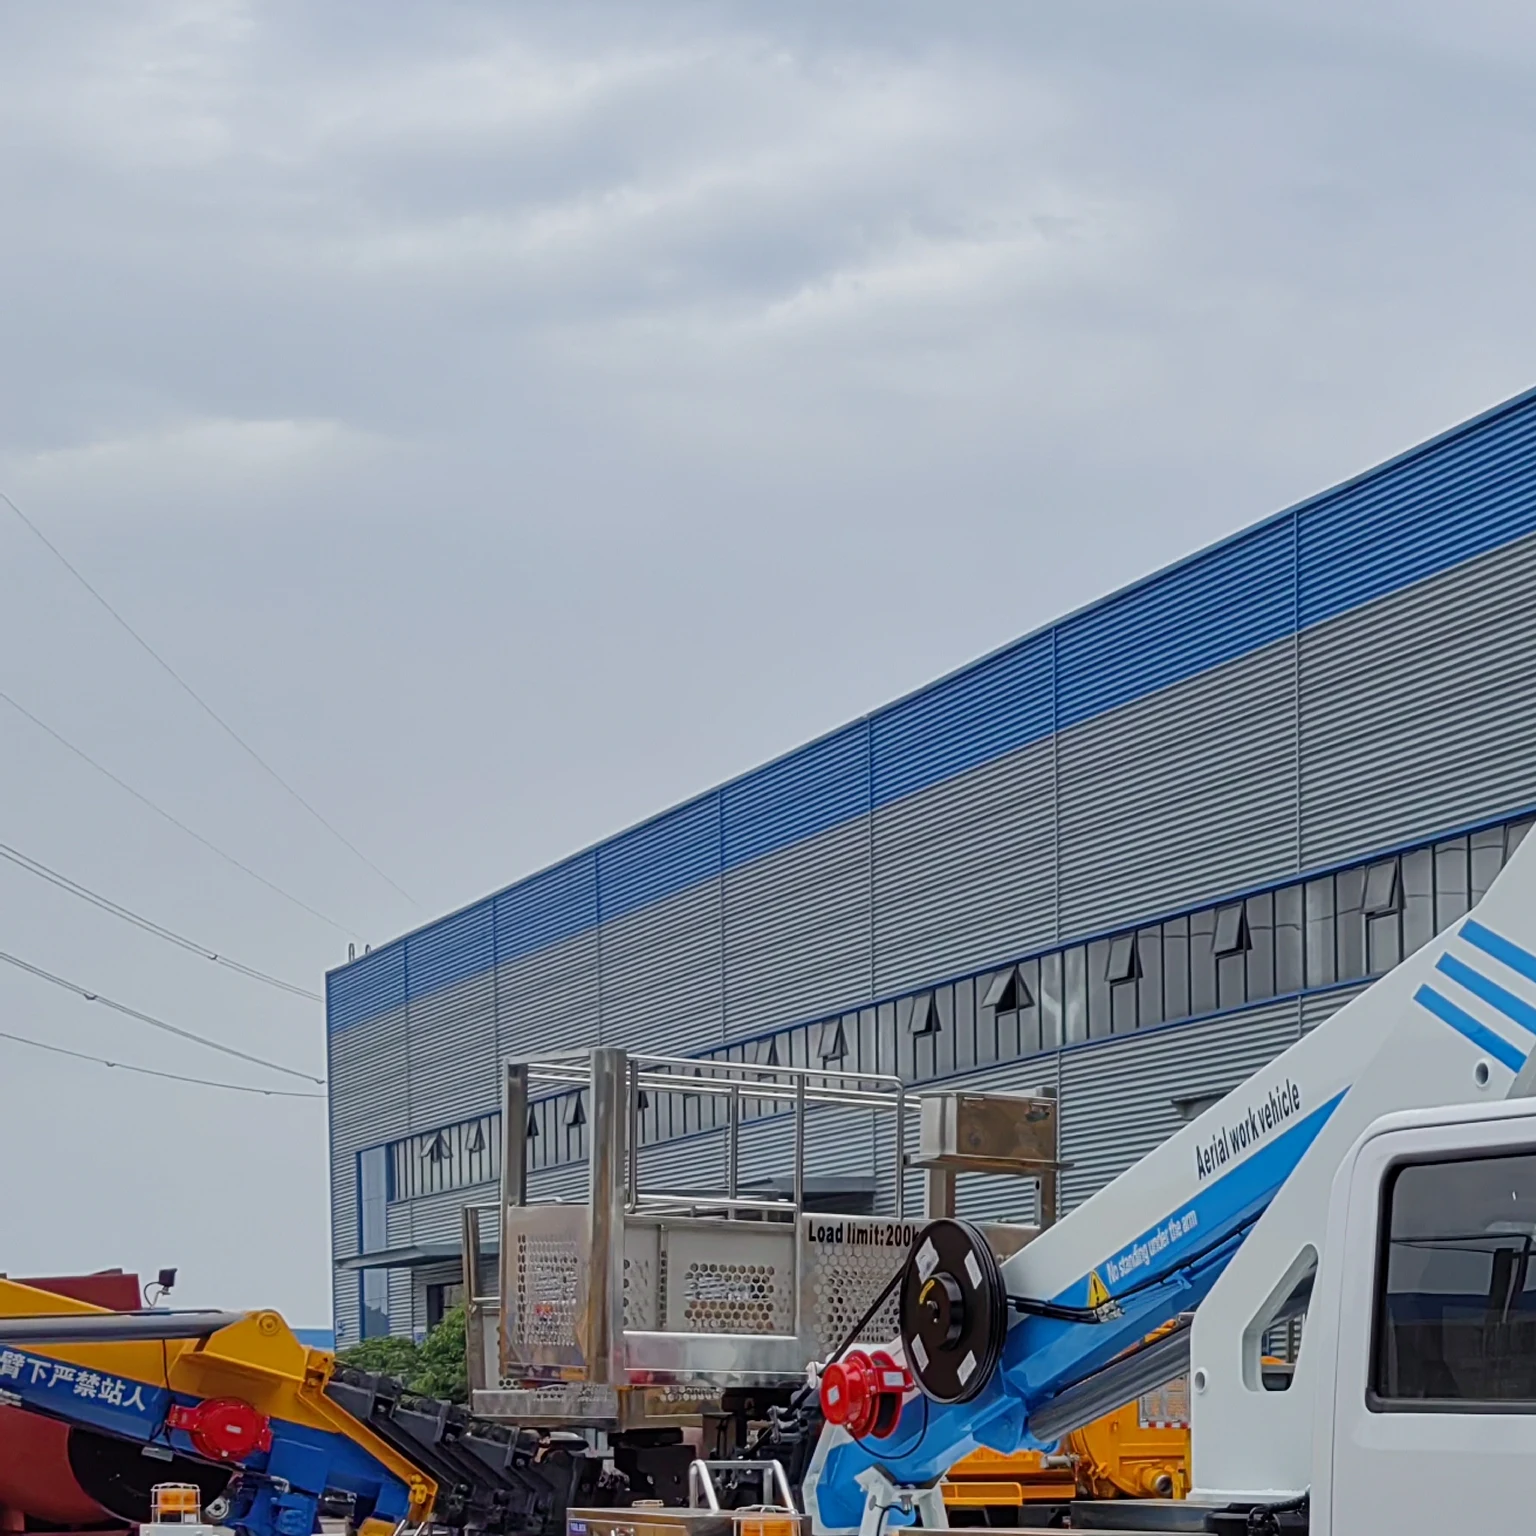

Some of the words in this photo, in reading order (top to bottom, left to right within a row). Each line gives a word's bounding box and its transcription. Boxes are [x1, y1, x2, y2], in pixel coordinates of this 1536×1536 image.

[1196, 1126, 1230, 1180] Aerial
[1229, 1108, 1259, 1155] work
[1258, 1079, 1300, 1133] vehicle
[808, 1220, 843, 1243] Load
[1106, 1257, 1118, 1284] No
[1118, 1238, 1150, 1278] standing
[1149, 1224, 1170, 1260] under
[1169, 1215, 1183, 1243] the
[1181, 1209, 1198, 1234] arm
[0, 1351, 146, 1411] 臂下严禁站人
